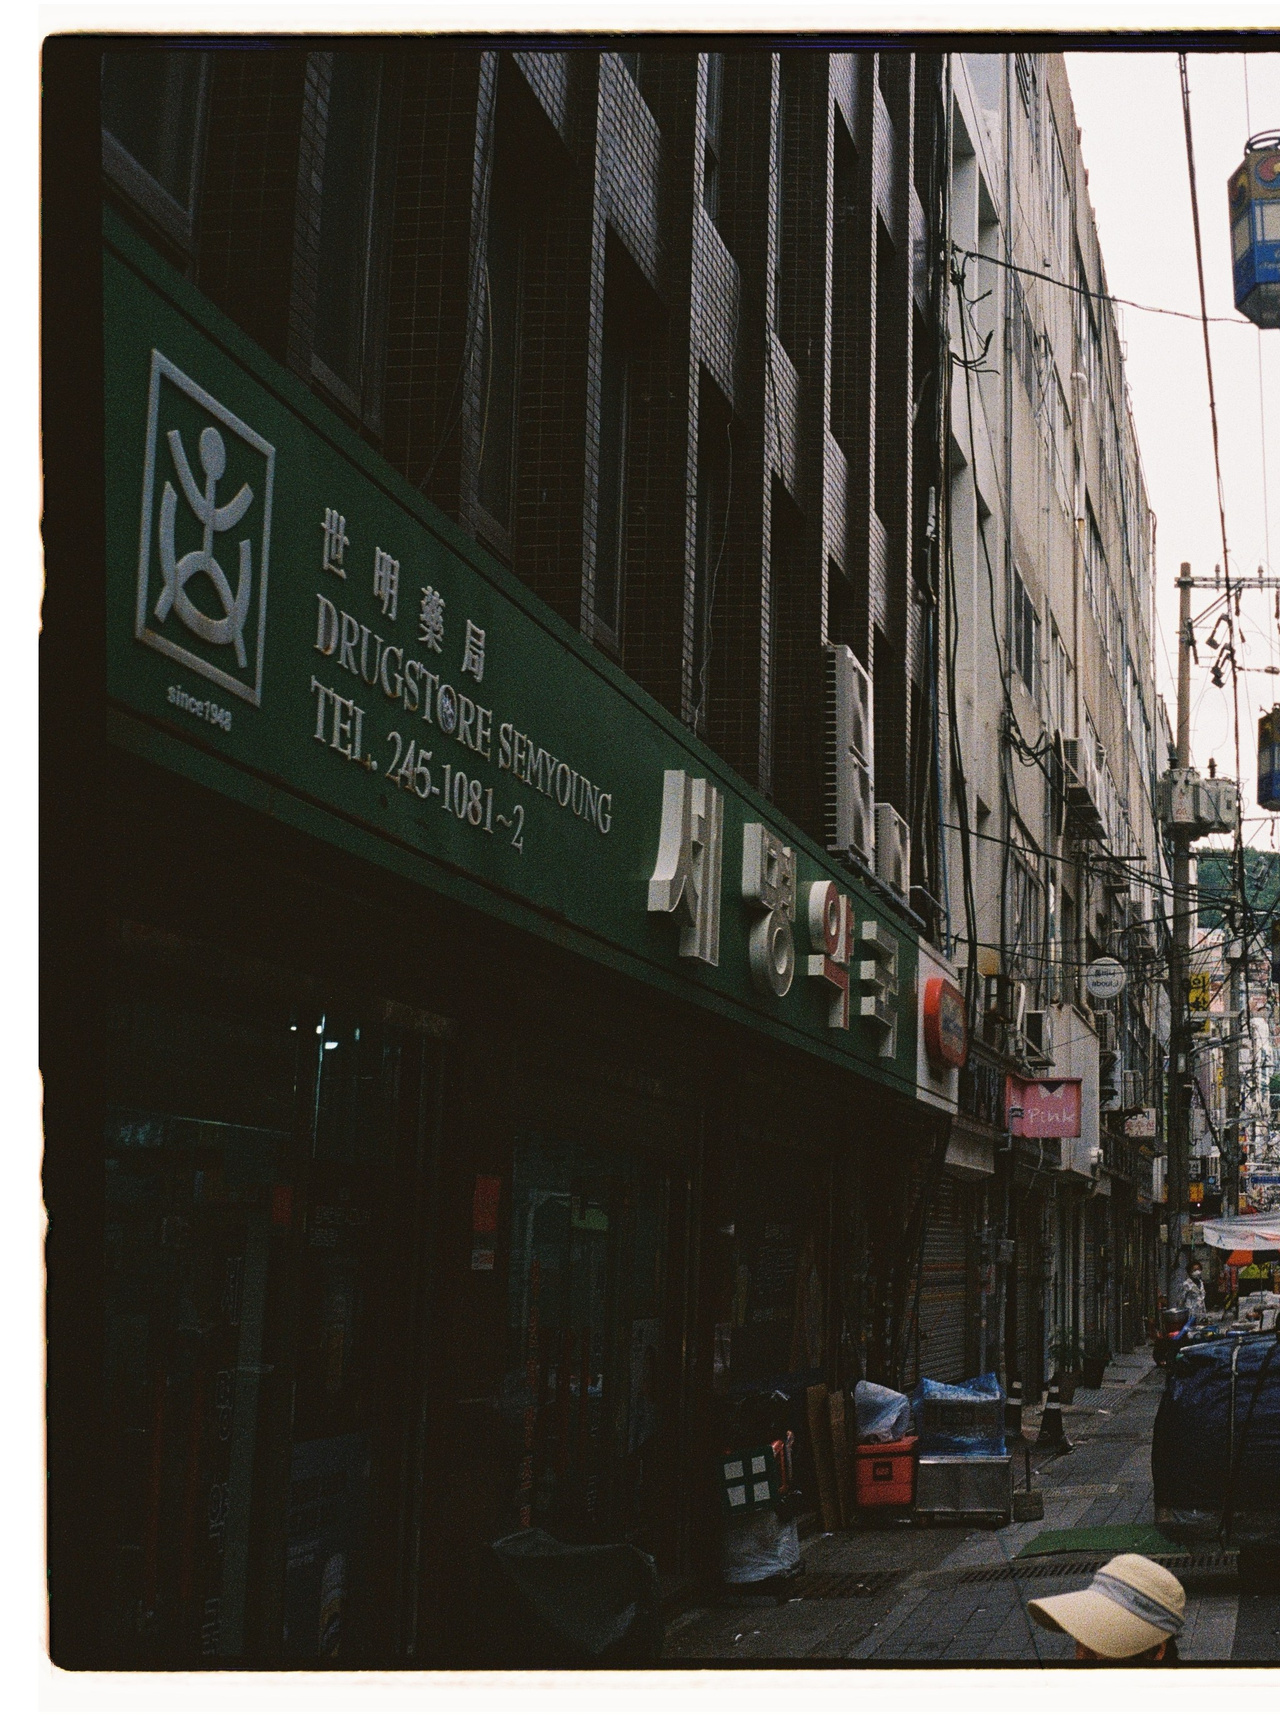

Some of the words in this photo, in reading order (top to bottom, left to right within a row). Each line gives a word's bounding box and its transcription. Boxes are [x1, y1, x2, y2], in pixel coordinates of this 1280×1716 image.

[320, 507, 487, 682] 世明藥局
[311, 675, 378, 771] TEL.
[314, 593, 492, 762] DRUGSTORE
[499, 722, 613, 835] SEMYOUNG
[648, 770, 899, 1060] 세명약국
[1027, 1107, 1076, 1124] Pink
